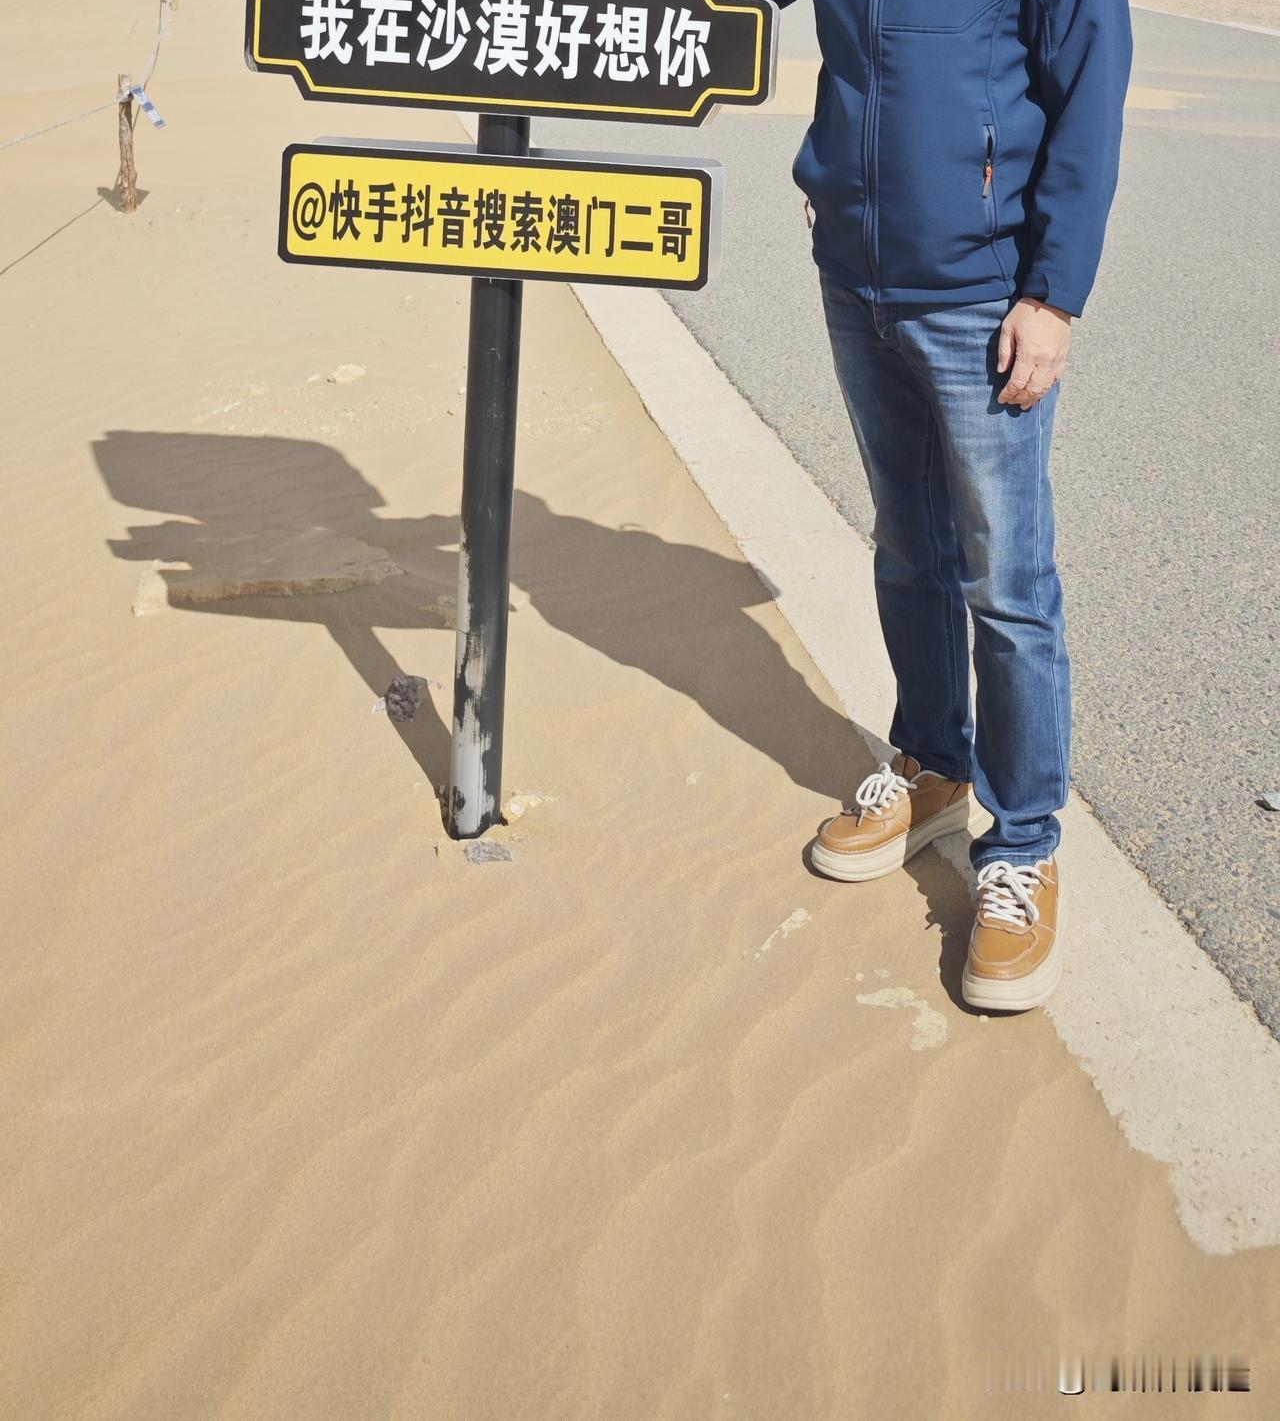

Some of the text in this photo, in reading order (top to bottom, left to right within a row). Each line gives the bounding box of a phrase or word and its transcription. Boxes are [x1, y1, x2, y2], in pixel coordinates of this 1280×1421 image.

[293, 179, 693, 263] @快手抖音搜索澳门二哥
